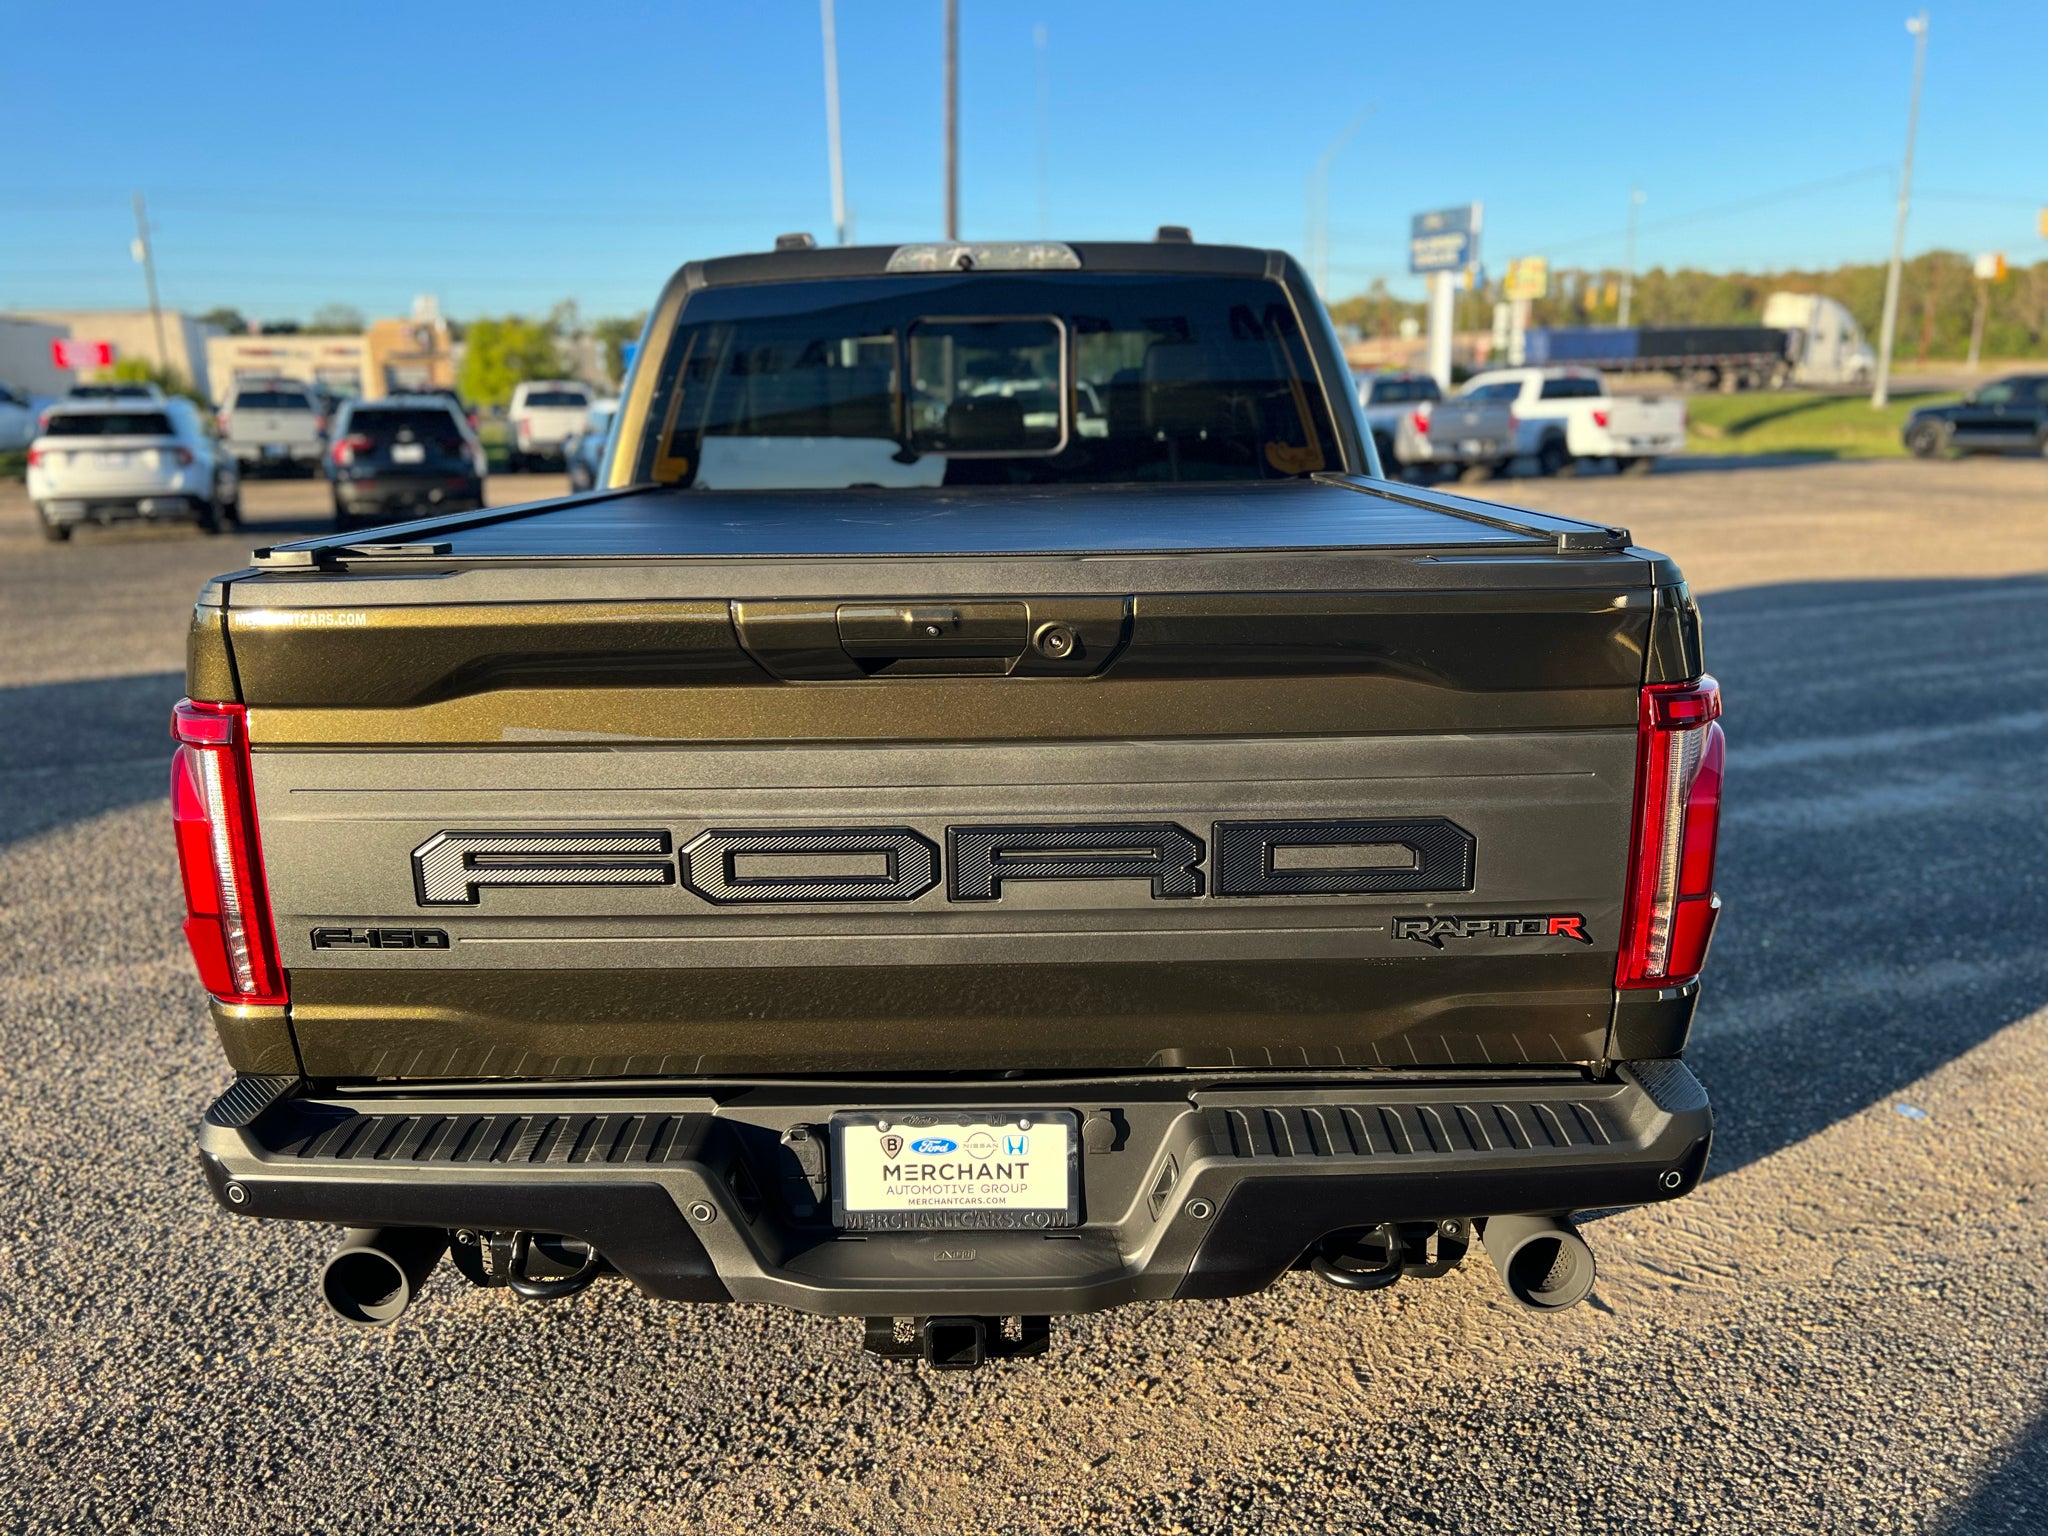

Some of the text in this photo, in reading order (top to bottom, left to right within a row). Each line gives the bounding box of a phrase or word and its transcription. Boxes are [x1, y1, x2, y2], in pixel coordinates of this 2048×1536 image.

[234, 612, 367, 626] MENTCARS.COM
[410, 816, 1478, 908] FORD
[310, 927, 451, 951] F-150
[1392, 912, 1594, 950] RAPTOR
[887, 1138, 898, 1151] B
[918, 1139, 949, 1152] Ford
[883, 1162, 1030, 1182] MERCHANT
[886, 1183, 1028, 1195] AUTOMOTIVE GROUP
[907, 1197, 1007, 1206] MERCHANTCARS.COM
[844, 1210, 1069, 1230] MERCHANTCARS.COM
